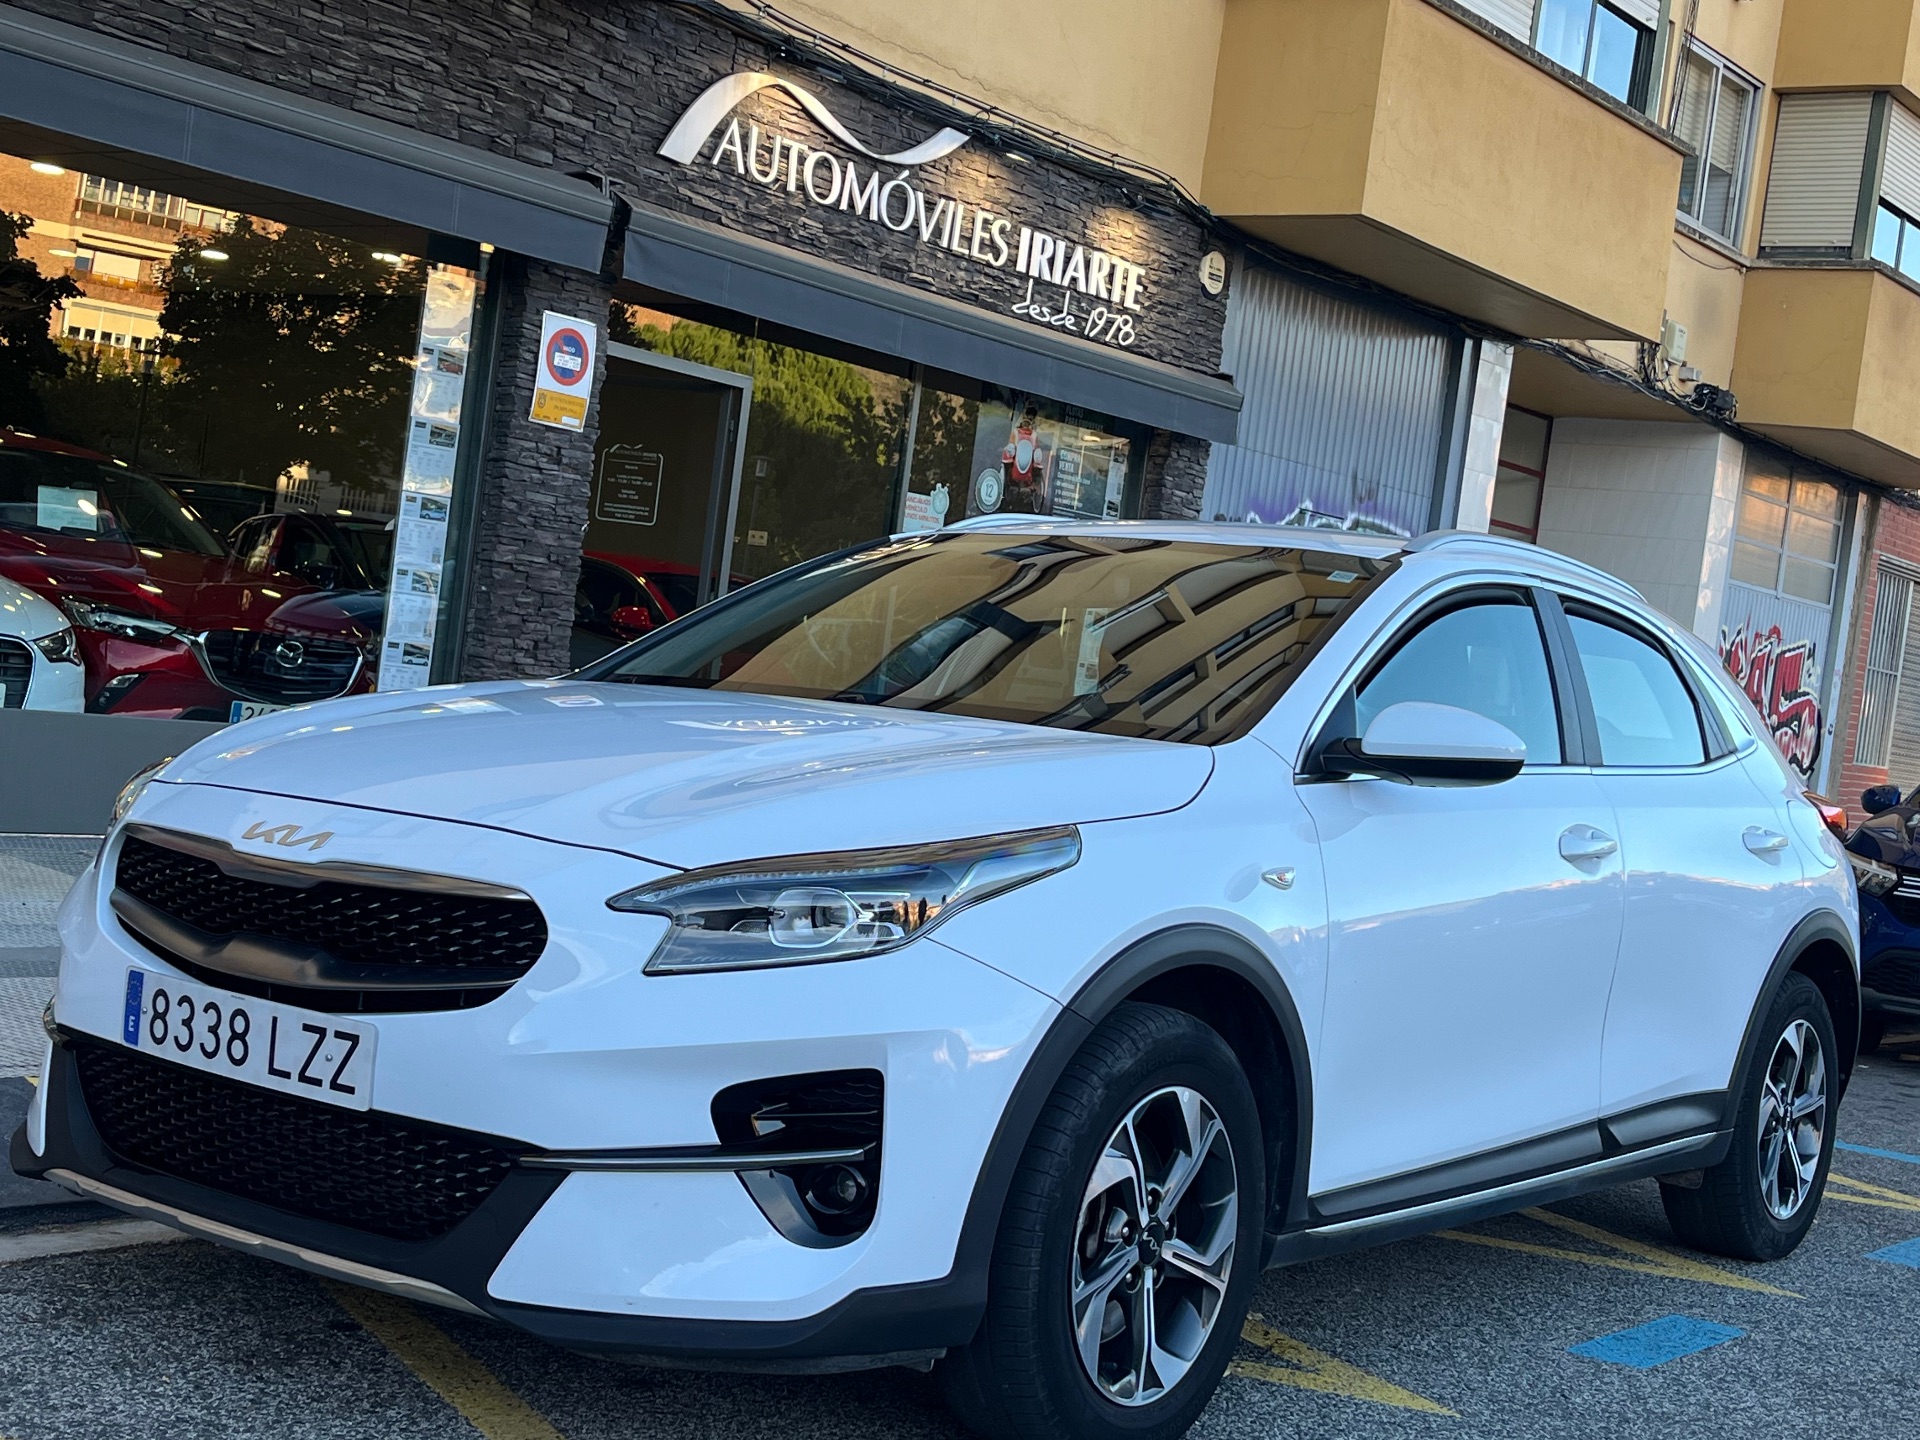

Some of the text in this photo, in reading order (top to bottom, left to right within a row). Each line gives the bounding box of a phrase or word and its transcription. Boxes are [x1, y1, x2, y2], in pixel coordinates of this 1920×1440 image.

[711, 117, 1146, 311] AUTOMÓVILES IRIARTE
[1011, 278, 1135, 345] desde 1978
[984, 483, 994, 498] 12
[128, 1015, 135, 1032] E
[149, 988, 360, 1095] 8338 LZZ
